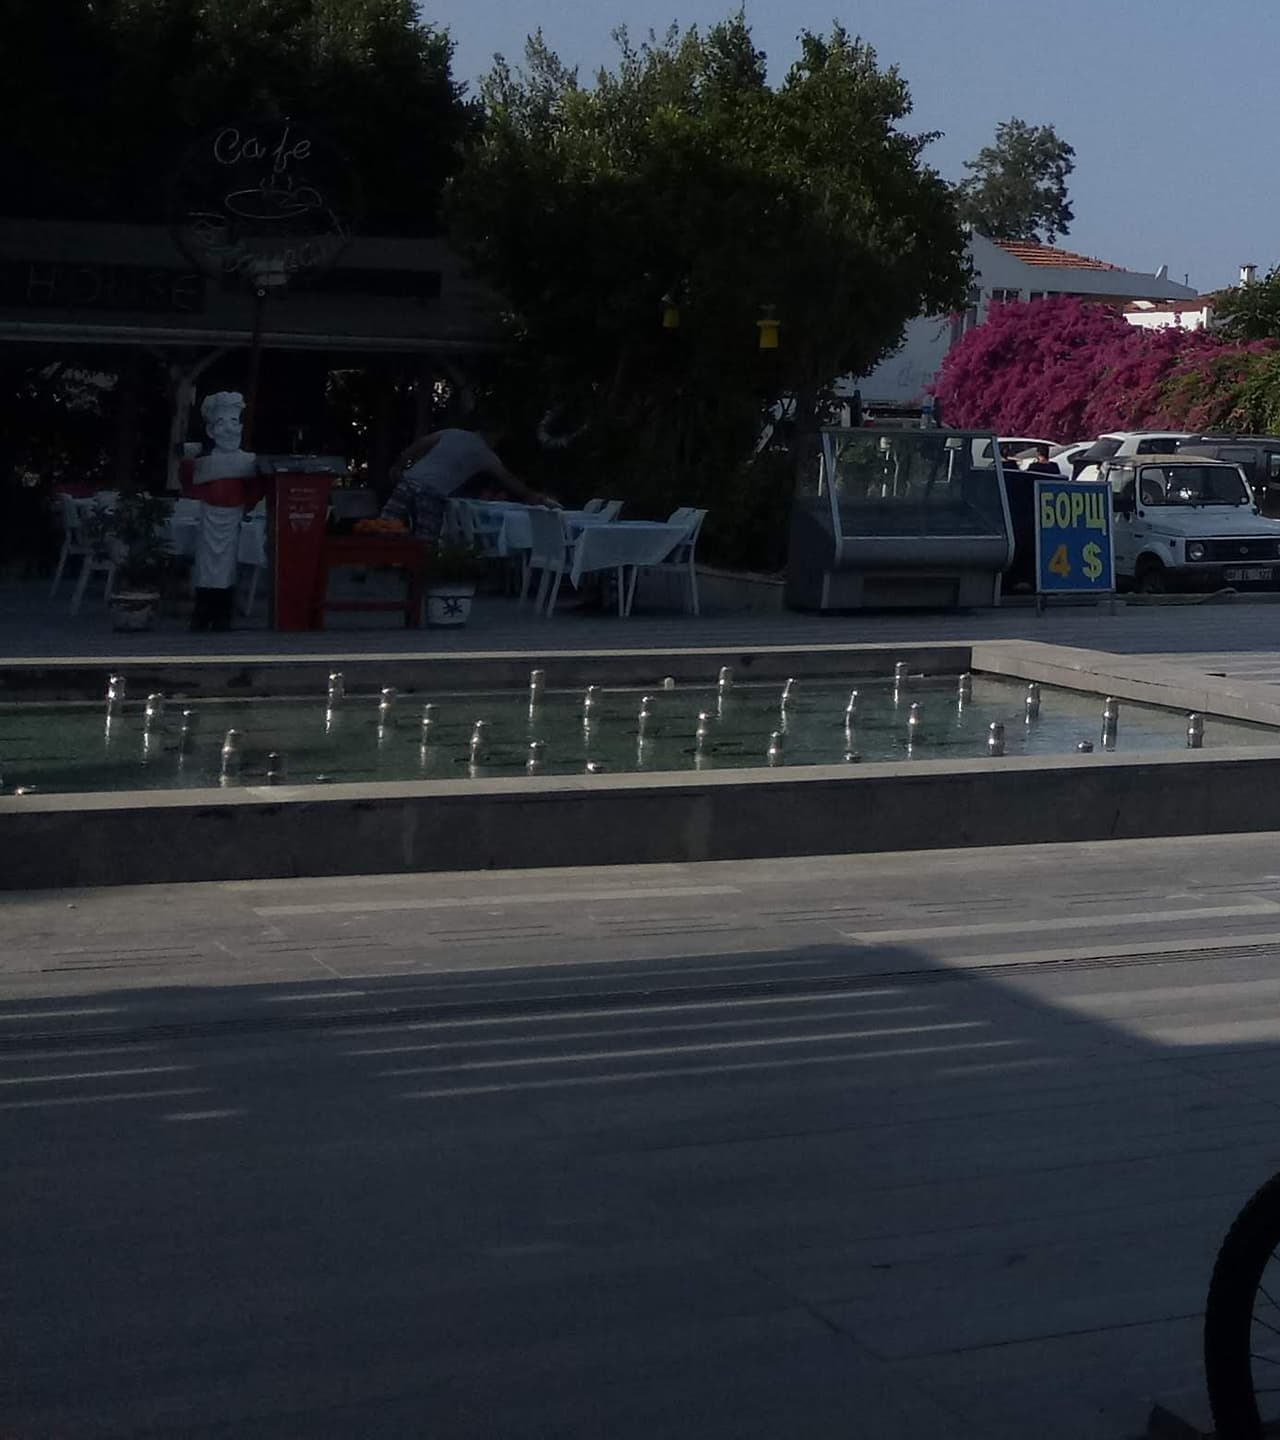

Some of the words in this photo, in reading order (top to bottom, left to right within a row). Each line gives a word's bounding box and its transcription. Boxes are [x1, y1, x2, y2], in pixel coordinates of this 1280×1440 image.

[213, 127, 313, 174] Cafe
[1040, 491, 1108, 536] БОРЩ
[1048, 543, 1071, 577] 4
[1081, 541, 1103, 583] $
